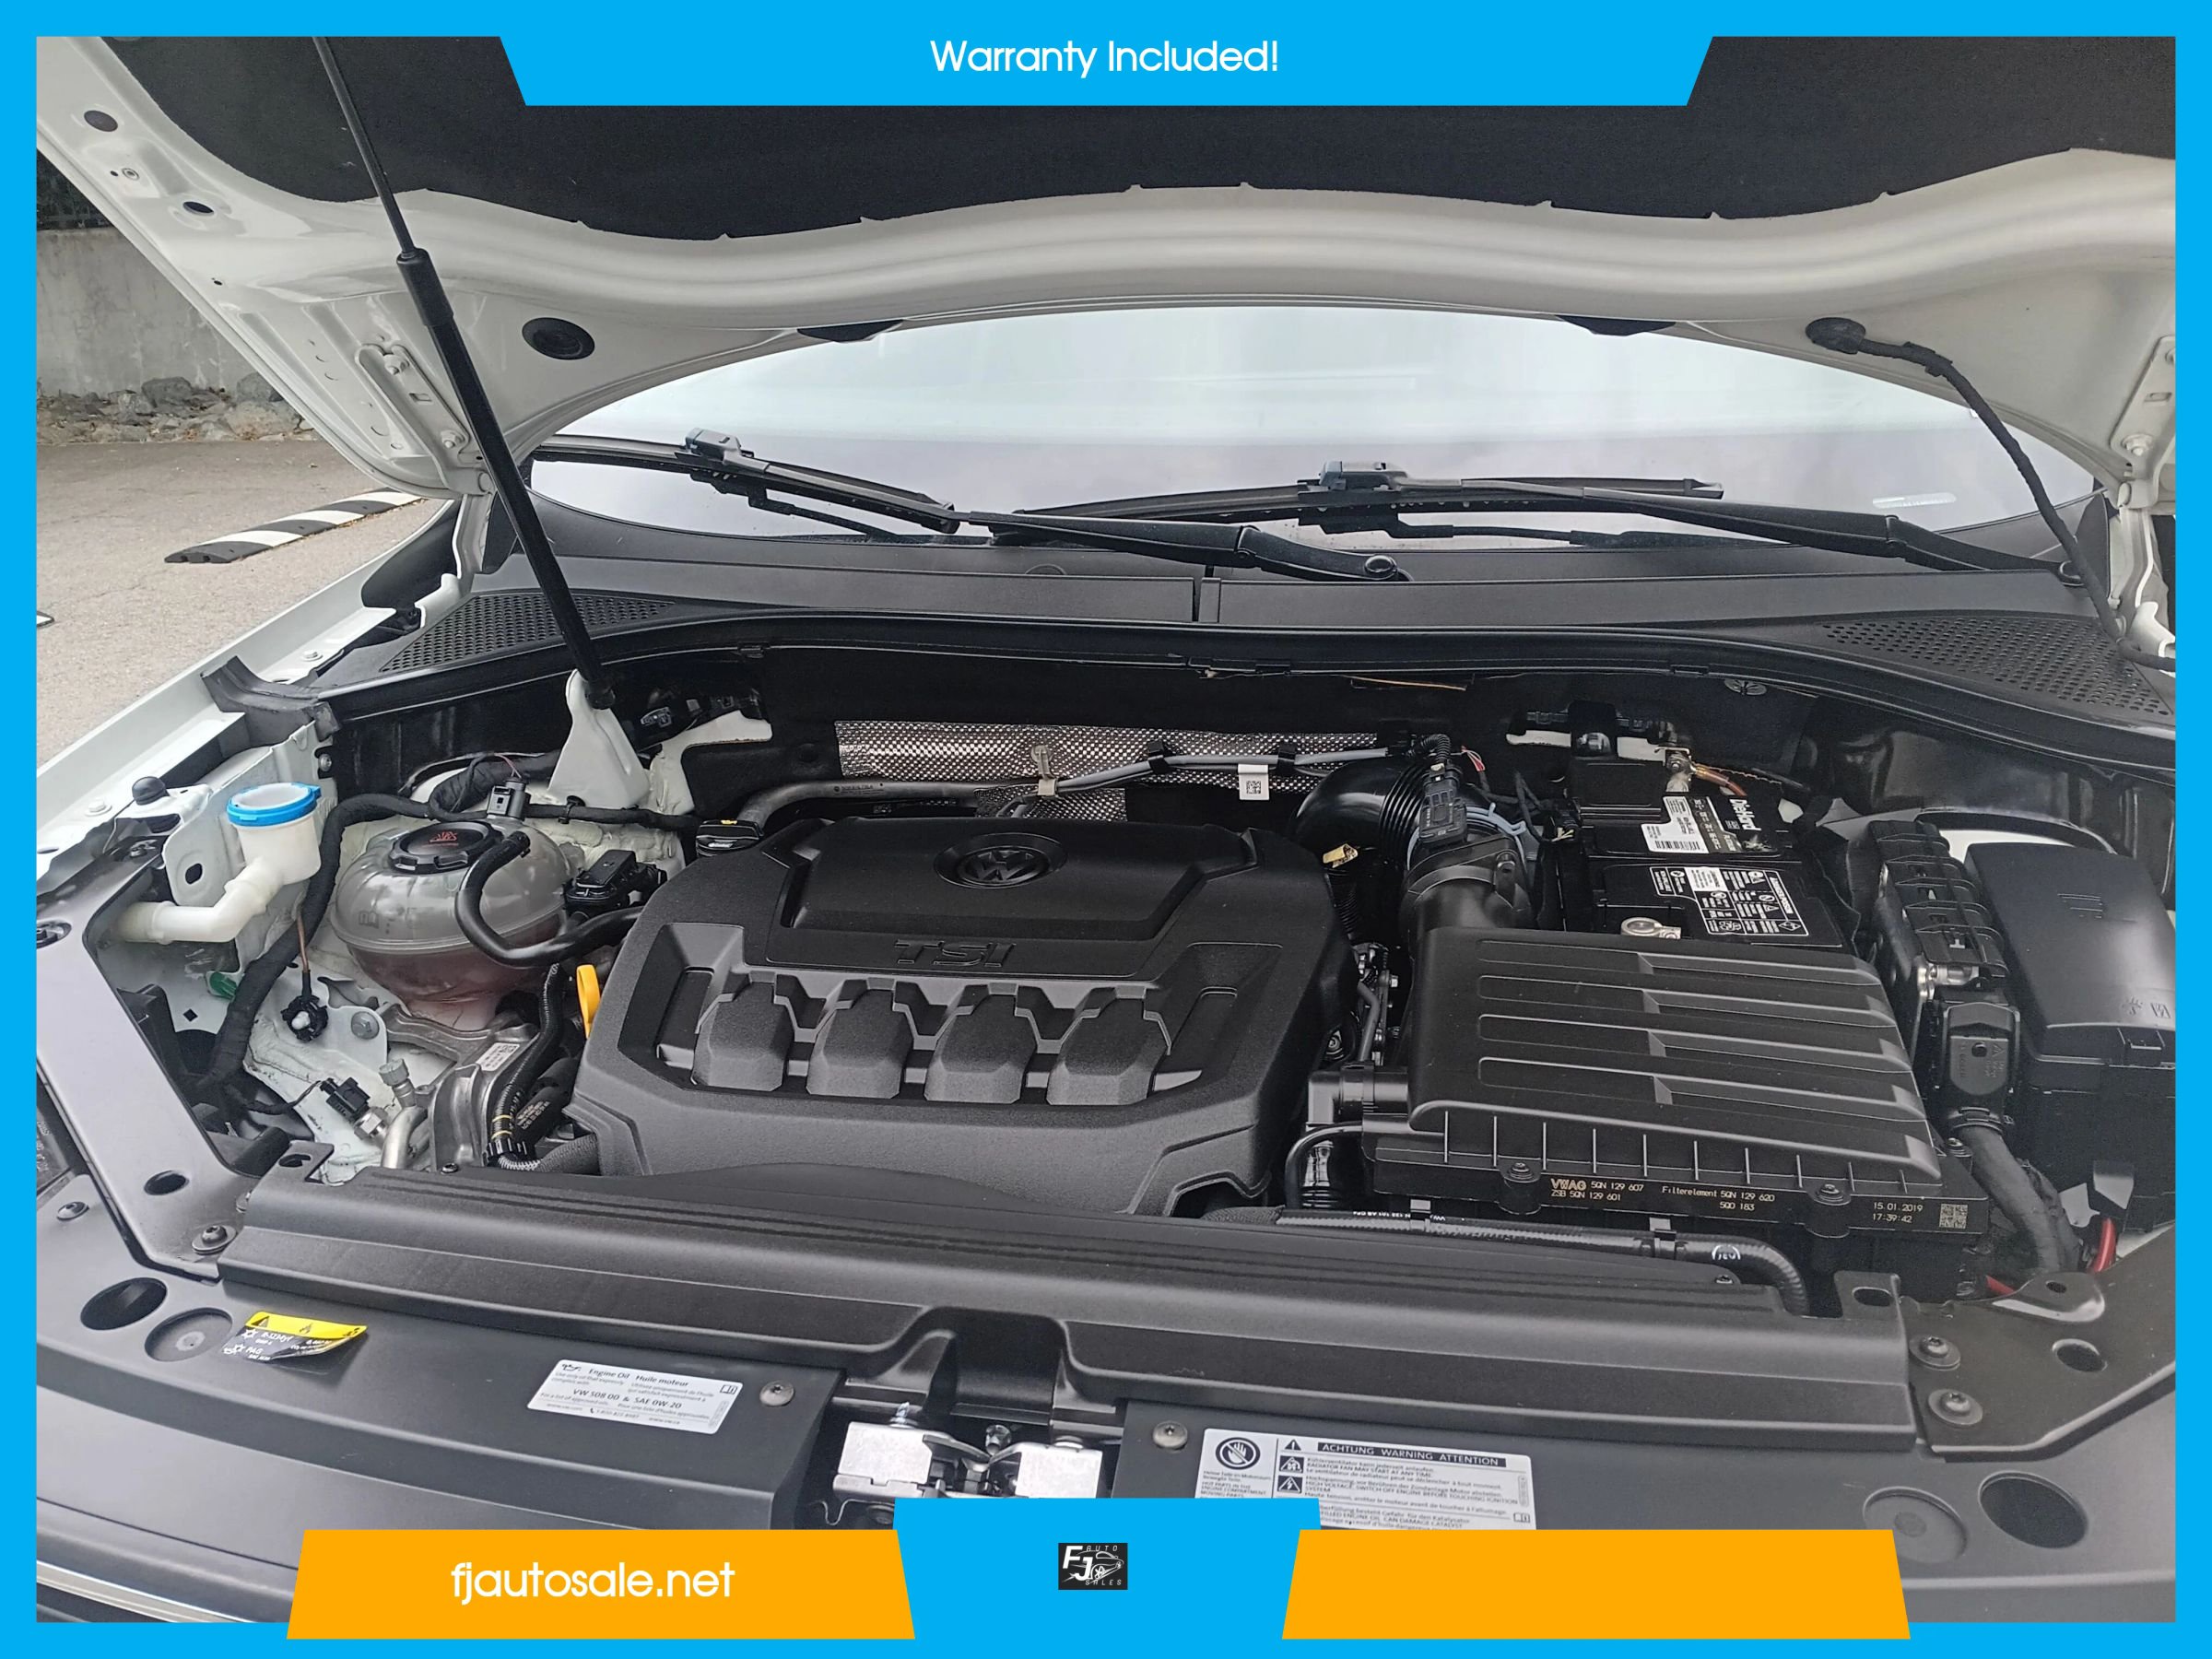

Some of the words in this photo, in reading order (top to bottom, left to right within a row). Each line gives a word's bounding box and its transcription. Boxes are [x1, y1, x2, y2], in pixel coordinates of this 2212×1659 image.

[1729, 798, 1761, 831] DieHard
[894, 938, 1017, 968] TSI
[1550, 1178, 1586, 1191] VWAG
[1591, 1181, 1607, 1190] 5QN
[1611, 1182, 1626, 1191] 129
[1628, 1183, 1644, 1192] 607
[1550, 1189, 1567, 1197] ZSB
[1569, 1190, 1585, 1199] 5QN
[1589, 1191, 1604, 1200] 129
[1606, 1193, 1621, 1201] 601
[1662, 1186, 1717, 1197] Filterelement
[1721, 1190, 1737, 1199] 5QN
[1740, 1192, 1756, 1200] 129
[1759, 1194, 1775, 1202] 620
[1739, 1202, 1755, 1210] 183
[1874, 1202, 1924, 1212] 15.01.2019
[1872, 1213, 1912, 1223] 17:39:42
[588, 1368, 615, 1380] Engine
[636, 1374, 657, 1382] Huile
[658, 1378, 689, 1387] moteur
[572, 1388, 590, 1396] VW
[607, 1393, 620, 1401] 00
[634, 1396, 652, 1405] SAE
[1323, 1443, 1374, 1455] ACHTUNG
[1382, 1449, 1433, 1460] WARNING
[1439, 1453, 1499, 1465] ATTENTION
